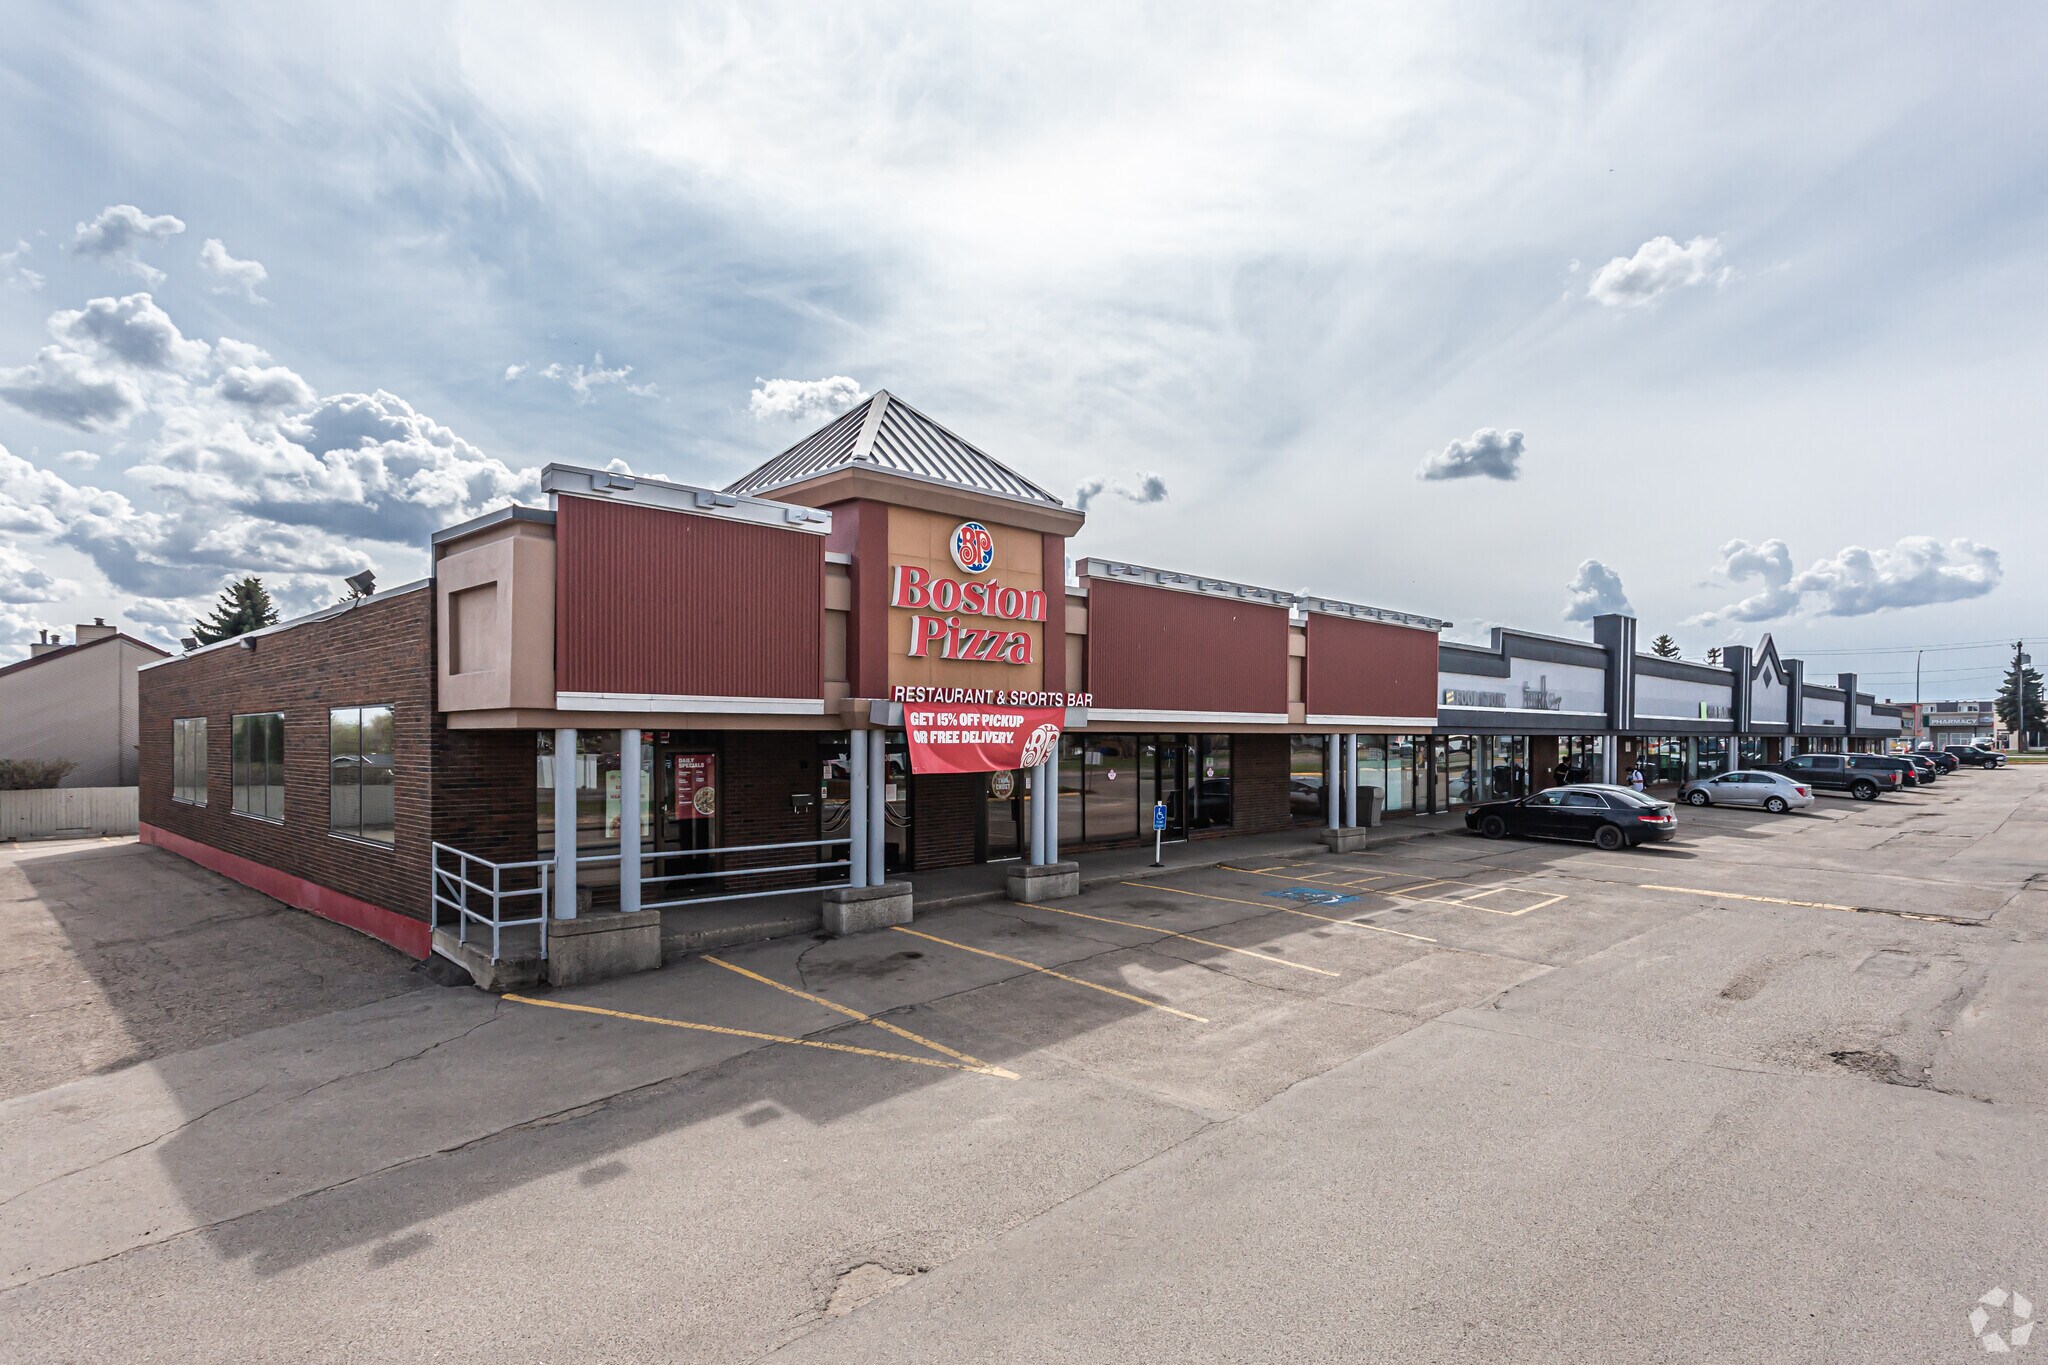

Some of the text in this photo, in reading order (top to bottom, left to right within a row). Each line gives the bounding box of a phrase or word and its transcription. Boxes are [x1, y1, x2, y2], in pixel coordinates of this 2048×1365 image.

[892, 565, 1047, 621] Boston
[908, 615, 1033, 664] Pizza
[894, 686, 1093, 707] RESTAURANT & SPORTS BAR
[910, 712, 1024, 728] GET 15% OFF PICKUP
[913, 730, 1014, 744] OR FREE DELIVERY.
